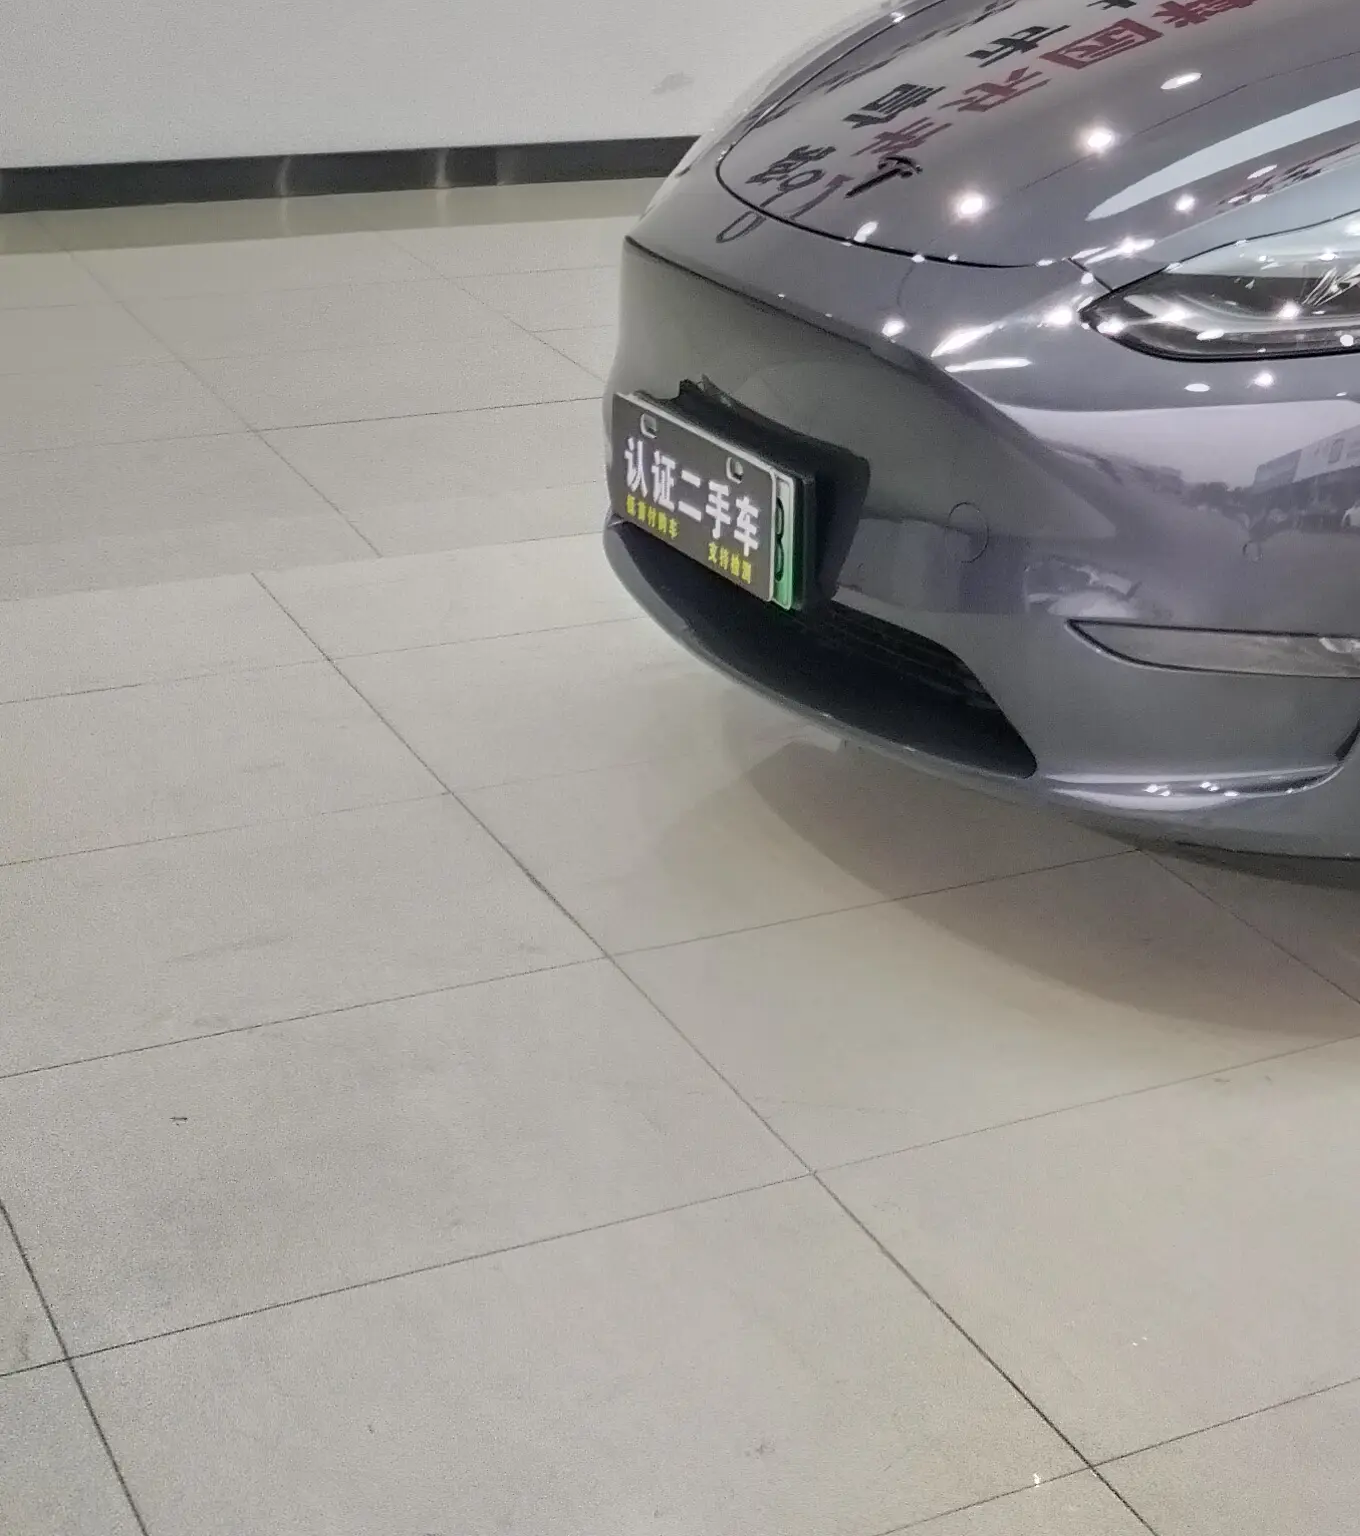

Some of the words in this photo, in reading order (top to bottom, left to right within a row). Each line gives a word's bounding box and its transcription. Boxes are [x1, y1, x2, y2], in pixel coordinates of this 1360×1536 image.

[624, 437, 760, 557] 认证二手车
